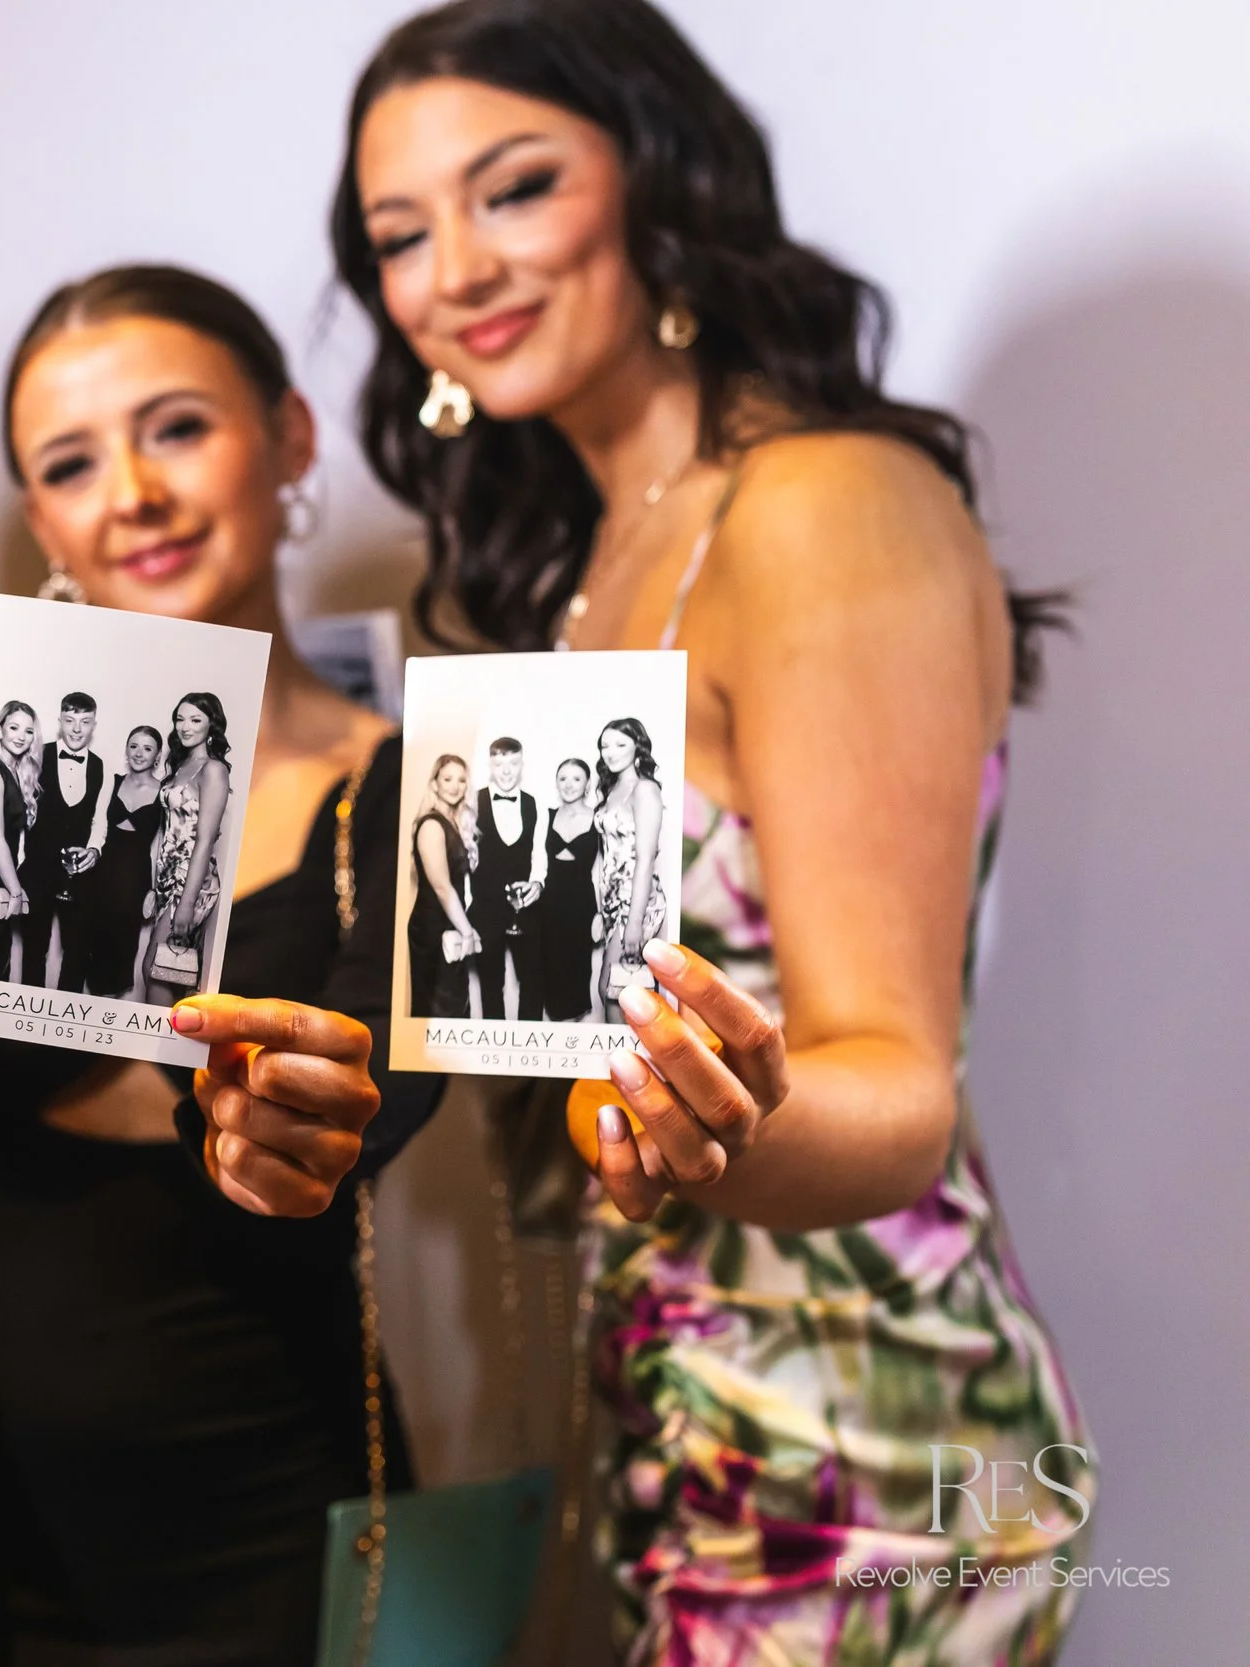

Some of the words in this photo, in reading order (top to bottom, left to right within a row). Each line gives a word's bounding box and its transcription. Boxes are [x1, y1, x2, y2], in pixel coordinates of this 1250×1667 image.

[15, 1019, 35, 1032] 05
[55, 1025, 75, 1039] 05
[95, 1032, 114, 1046] 23
[102, 1011, 118, 1025] &
[126, 1012, 174, 1035] AMY
[425, 1028, 555, 1048] MACAULAY
[565, 1036, 580, 1050] &
[589, 1034, 641, 1051] AMY
[481, 1054, 500, 1065] 05
[520, 1055, 540, 1067] 05
[560, 1056, 580, 1069] 23
